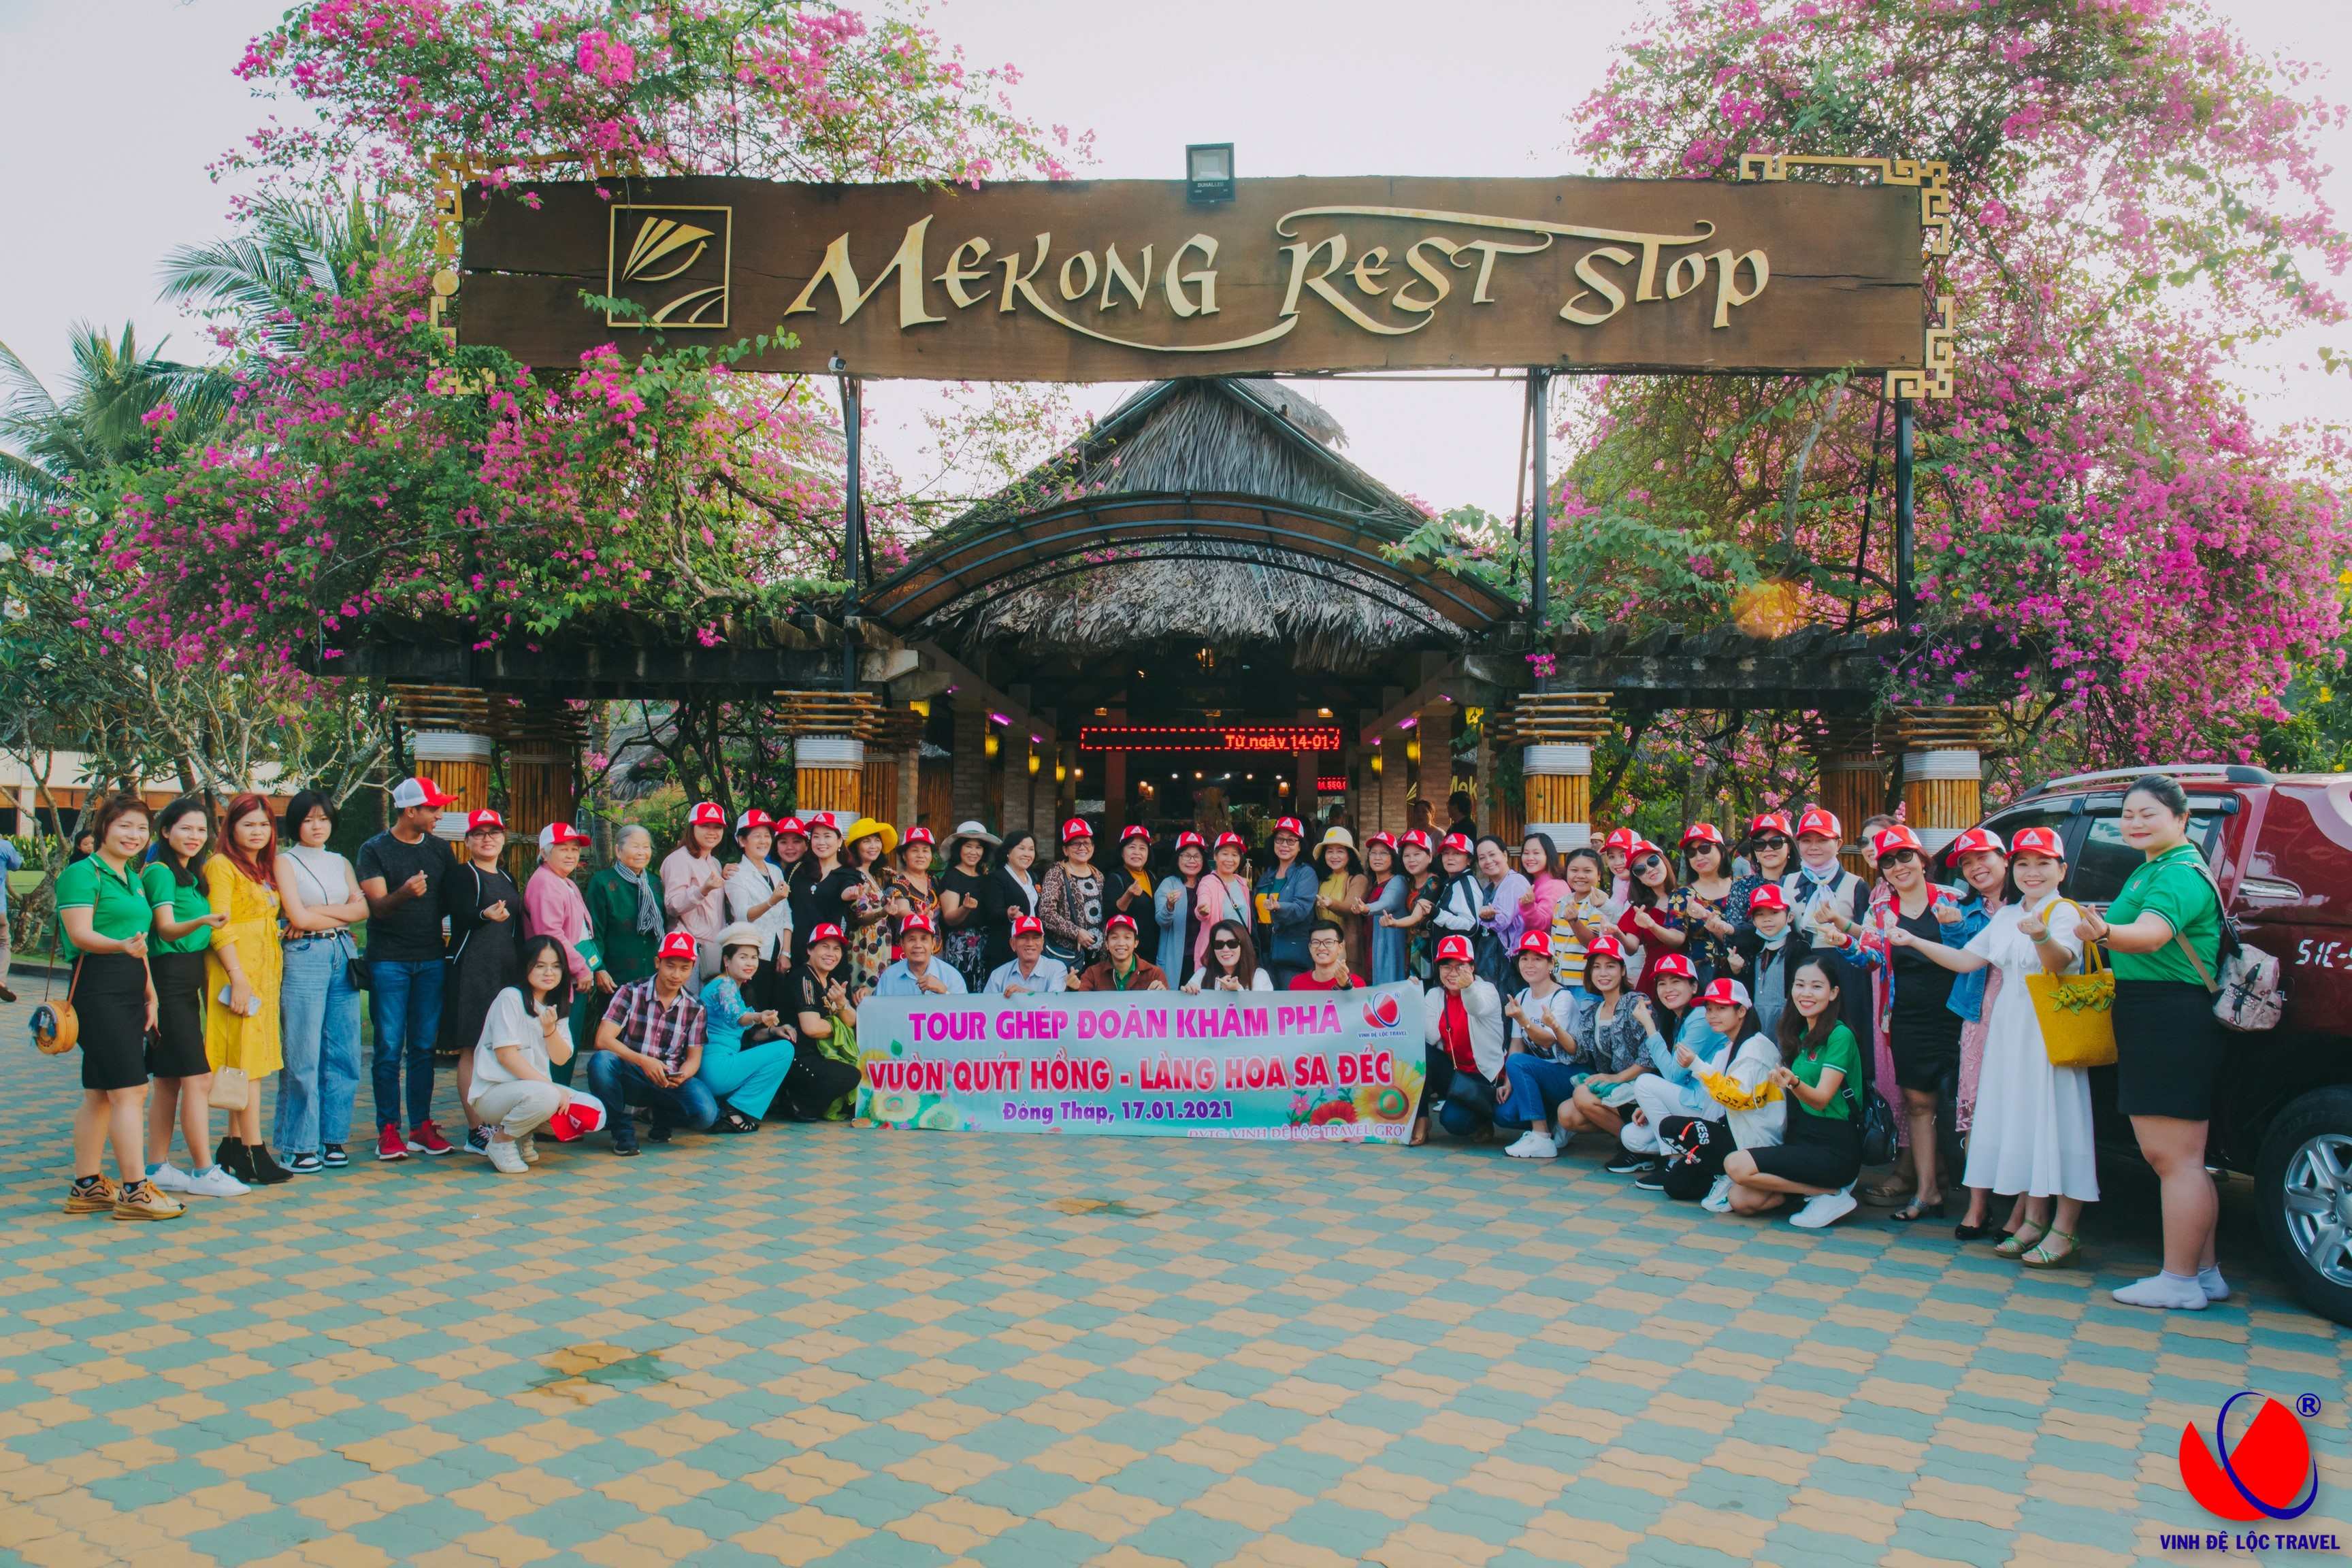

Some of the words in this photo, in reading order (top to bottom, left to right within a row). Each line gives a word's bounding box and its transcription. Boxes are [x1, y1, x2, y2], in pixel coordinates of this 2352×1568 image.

[1225, 734, 1245, 747] Từ
[909, 1012, 987, 1041] TOUR
[996, 1005, 1068, 1040] GHÉP
[1077, 1004, 1167, 1039] ĐOÀN
[1177, 1003, 1269, 1038] KHÁM
[1277, 1000, 1342, 1035] PHÁ
[867, 1054, 945, 1092] VƯỜN
[953, 1052, 1022, 1094] QUÝT
[1030, 1047, 1111, 1092] HỒNG
[1140, 1051, 1215, 1090] LÀNG
[1225, 1057, 1288, 1090] HOA
[1294, 1055, 1330, 1088] SA
[1337, 1044, 1392, 1085] ĐÉC
[1002, 1099, 1053, 1124] Đồng
[1060, 1100, 1115, 1124] Tháp,
[1122, 1099, 1233, 1120] 17.01.2021
[1232, 1128, 1266, 1138] VINH
[1294, 1124, 1319, 1139] LỘC
[1323, 1124, 1370, 1137] TRAVEL
[1375, 1124, 1405, 1137] GRO
